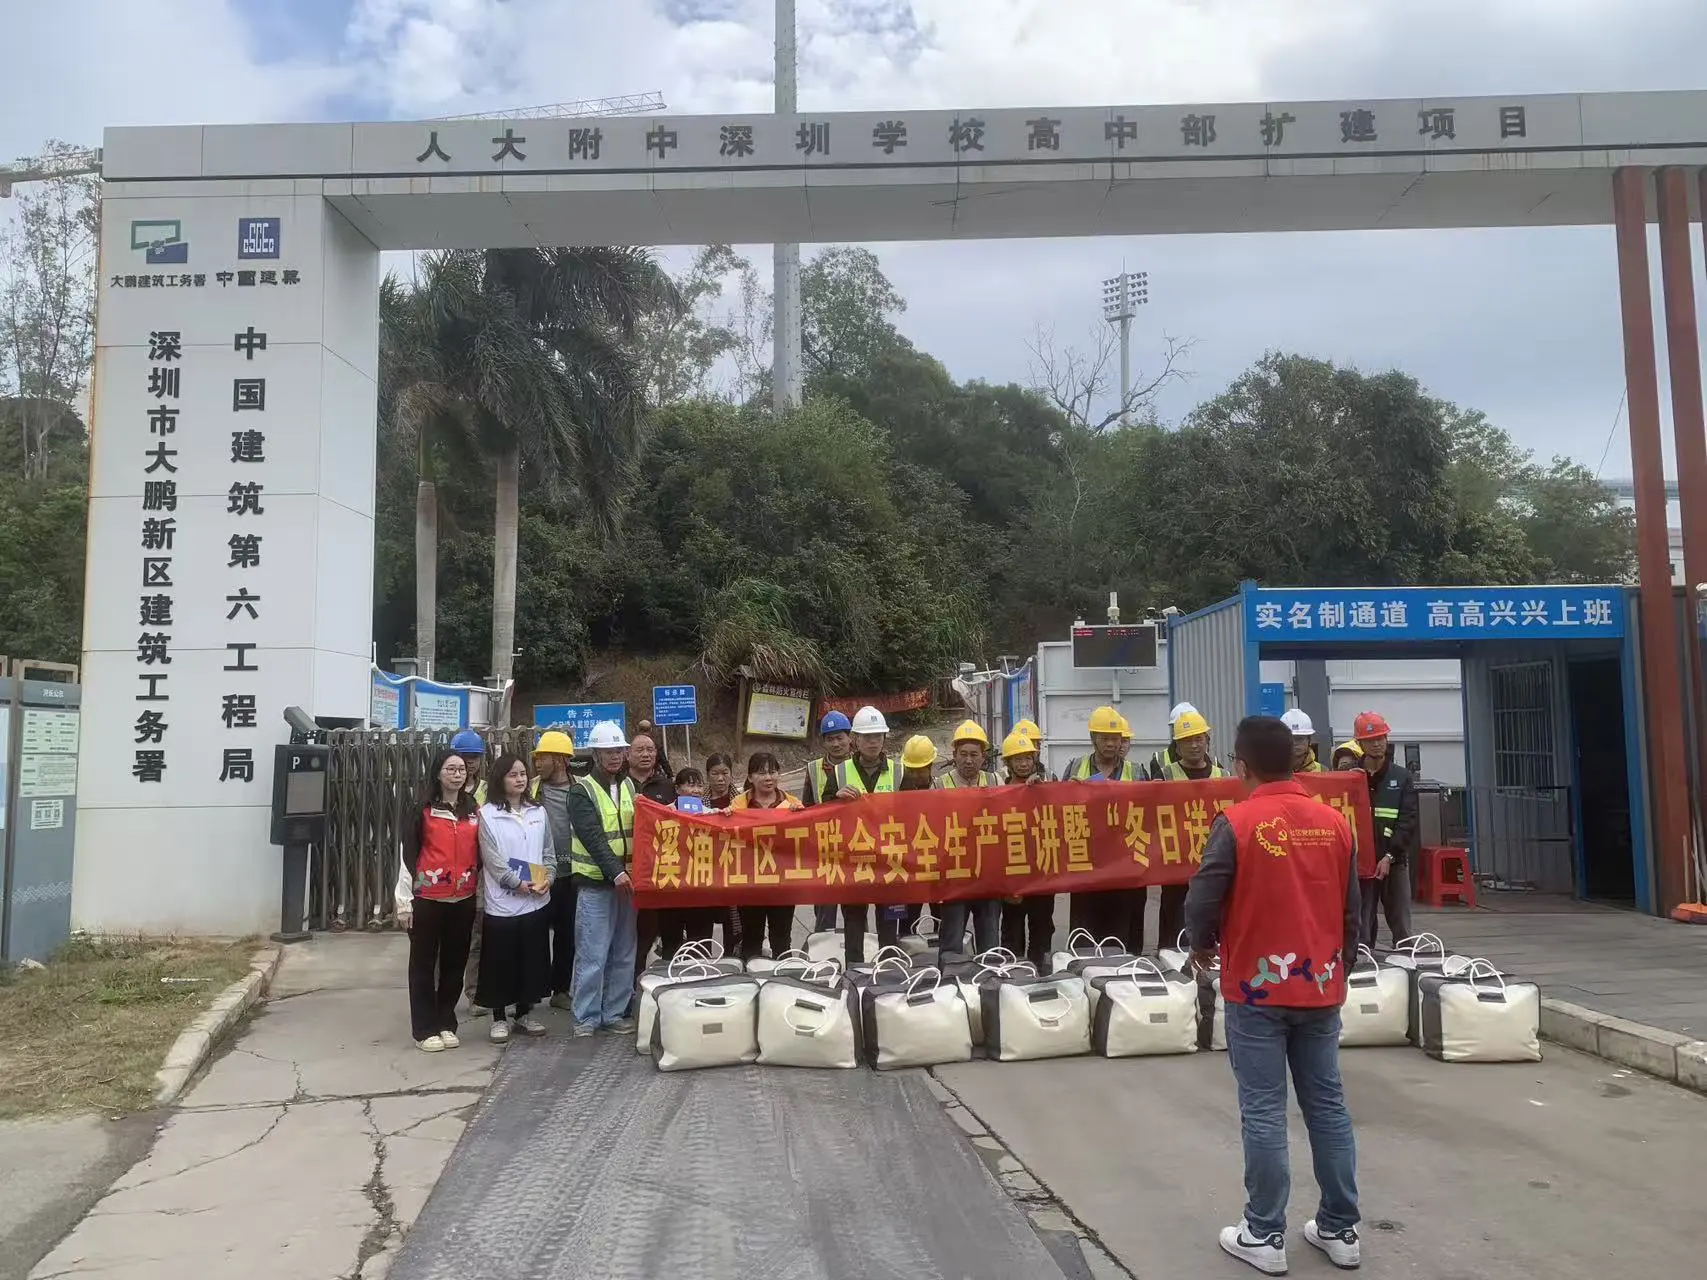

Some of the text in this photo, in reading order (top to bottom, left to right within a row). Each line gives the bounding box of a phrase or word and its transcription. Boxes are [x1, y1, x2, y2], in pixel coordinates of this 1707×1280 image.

[416, 105, 1527, 162] 人大附中深圳学校高中部扩建项目
[110, 273, 206, 288] 大鹏建筑工务署
[132, 331, 181, 783] 深圳市大鹏新区建筑工务署
[219, 326, 267, 783] 中国建筑第六工程局
[1255, 599, 1613, 630] 实名制通道 高高兴兴上班
[567, 708, 594, 719] 告示
[292, 756, 301, 770] P
